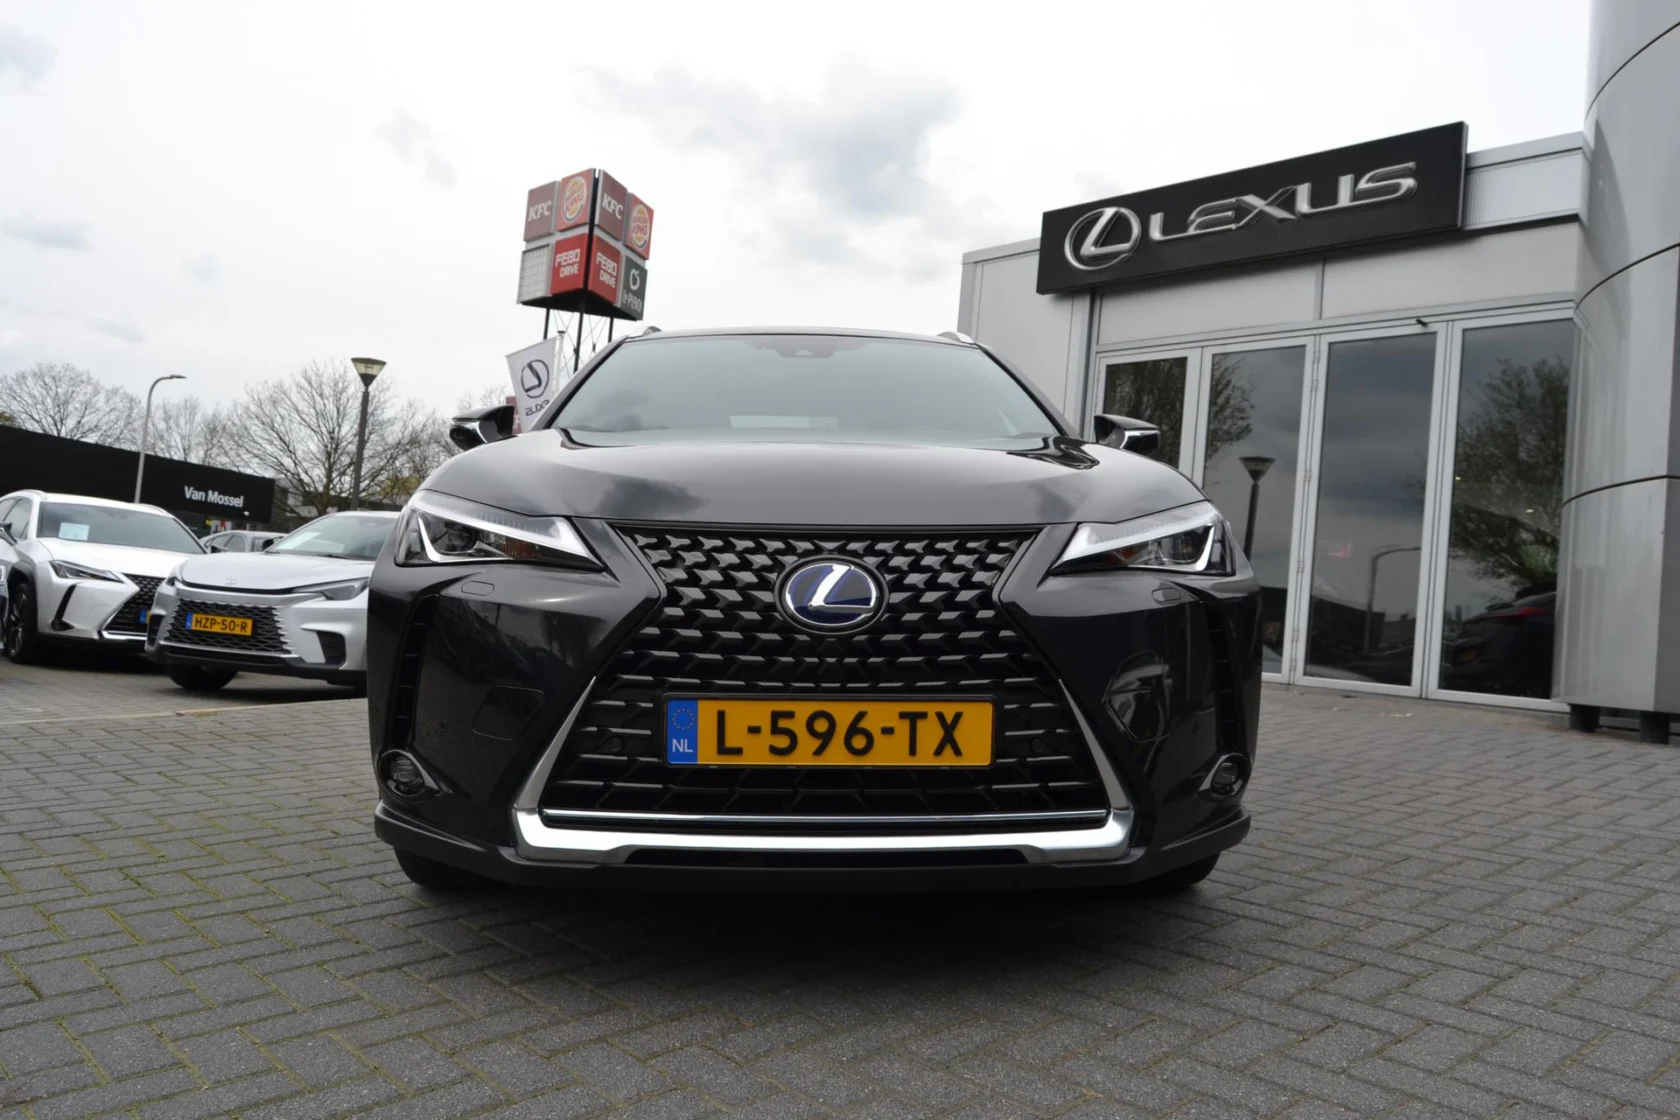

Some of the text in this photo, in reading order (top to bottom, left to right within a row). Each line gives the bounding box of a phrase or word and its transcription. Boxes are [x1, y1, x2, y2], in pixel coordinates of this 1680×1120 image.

[527, 200, 552, 222] KFC
[601, 193, 624, 220] KFC
[1149, 161, 1417, 243] LEXUS
[555, 248, 581, 267] FEBO
[595, 251, 618, 277] FEBO
[559, 263, 579, 278] DRIVE
[184, 485, 244, 508] Van Mossel
[195, 617, 249, 634] HZP-50-R
[715, 709, 964, 757] L-596-TX
[671, 738, 694, 754] NL
